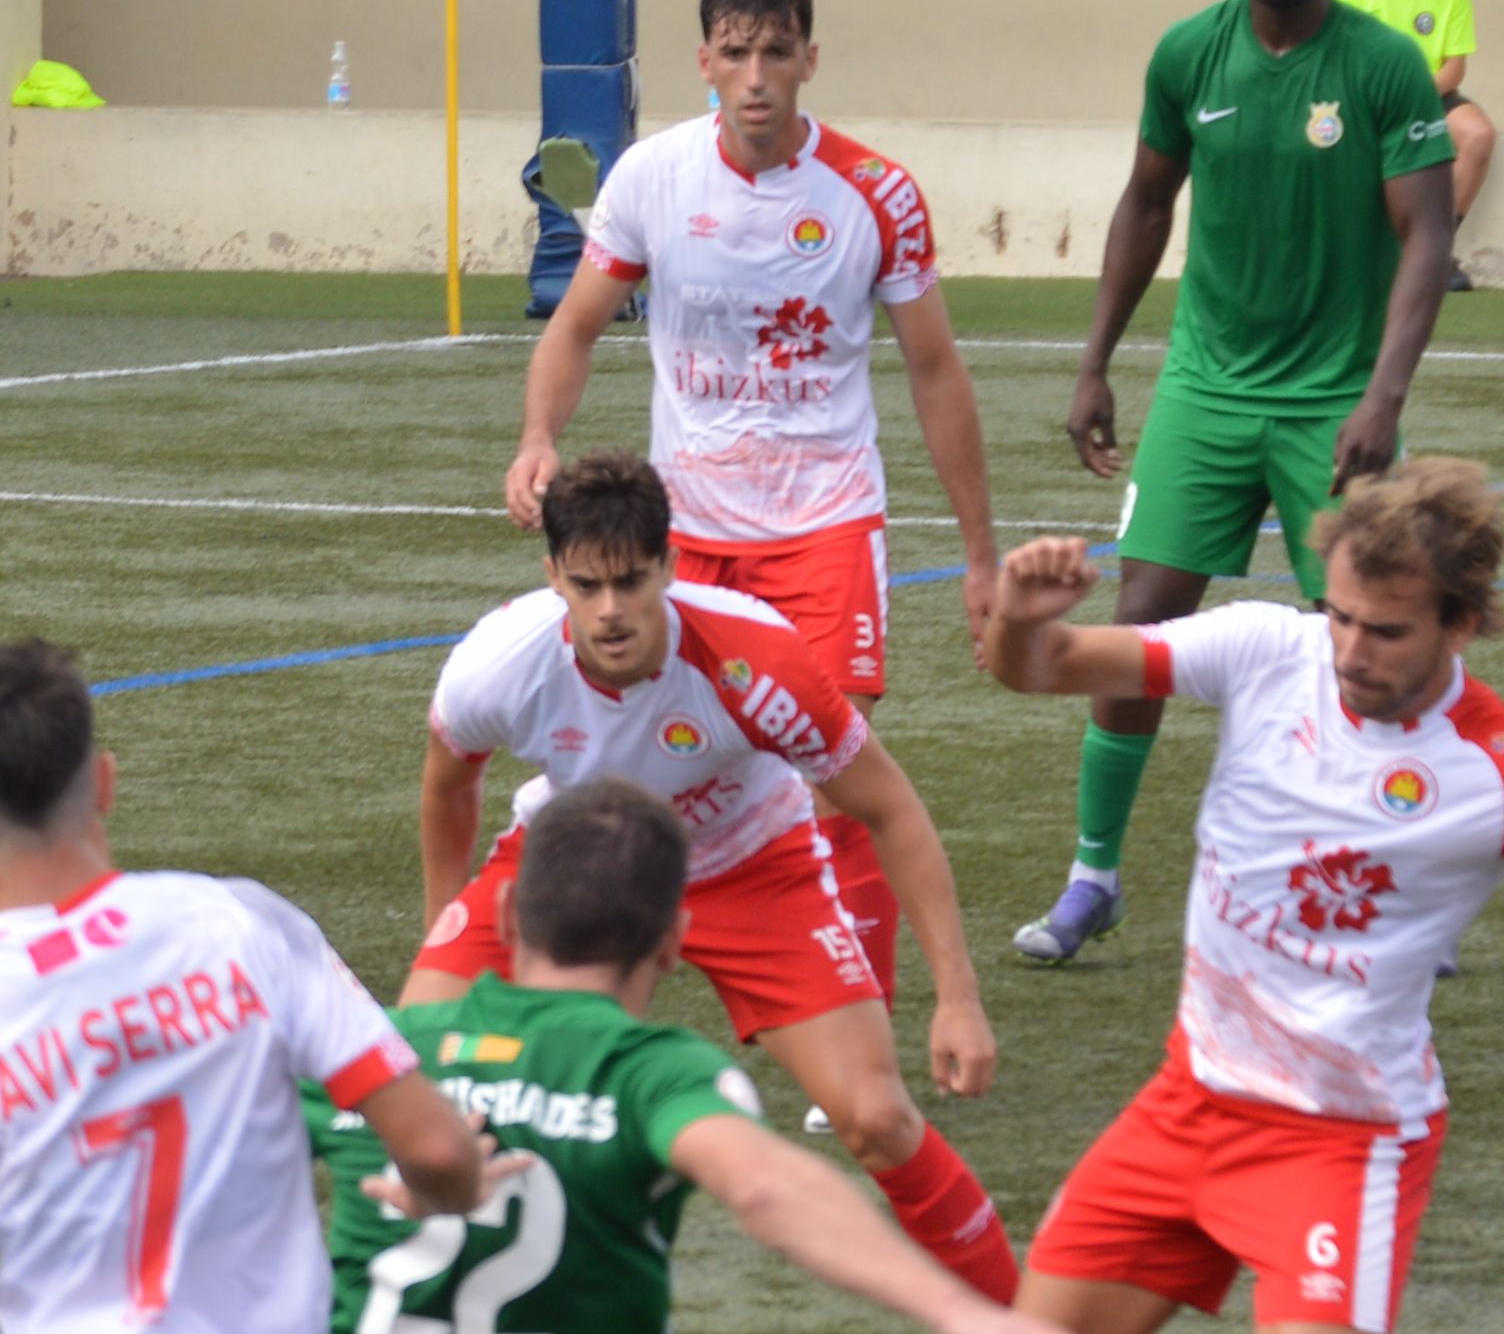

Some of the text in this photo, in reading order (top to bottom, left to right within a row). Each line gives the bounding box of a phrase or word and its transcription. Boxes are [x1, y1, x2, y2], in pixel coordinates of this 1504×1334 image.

[674, 350, 833, 403] ibizkus
[853, 613, 875, 649] 3
[811, 924, 855, 961] 15
[80, 962, 271, 1079] SERRA
[75, 1095, 189, 1326] 7
[1306, 1221, 1341, 1268] 6
